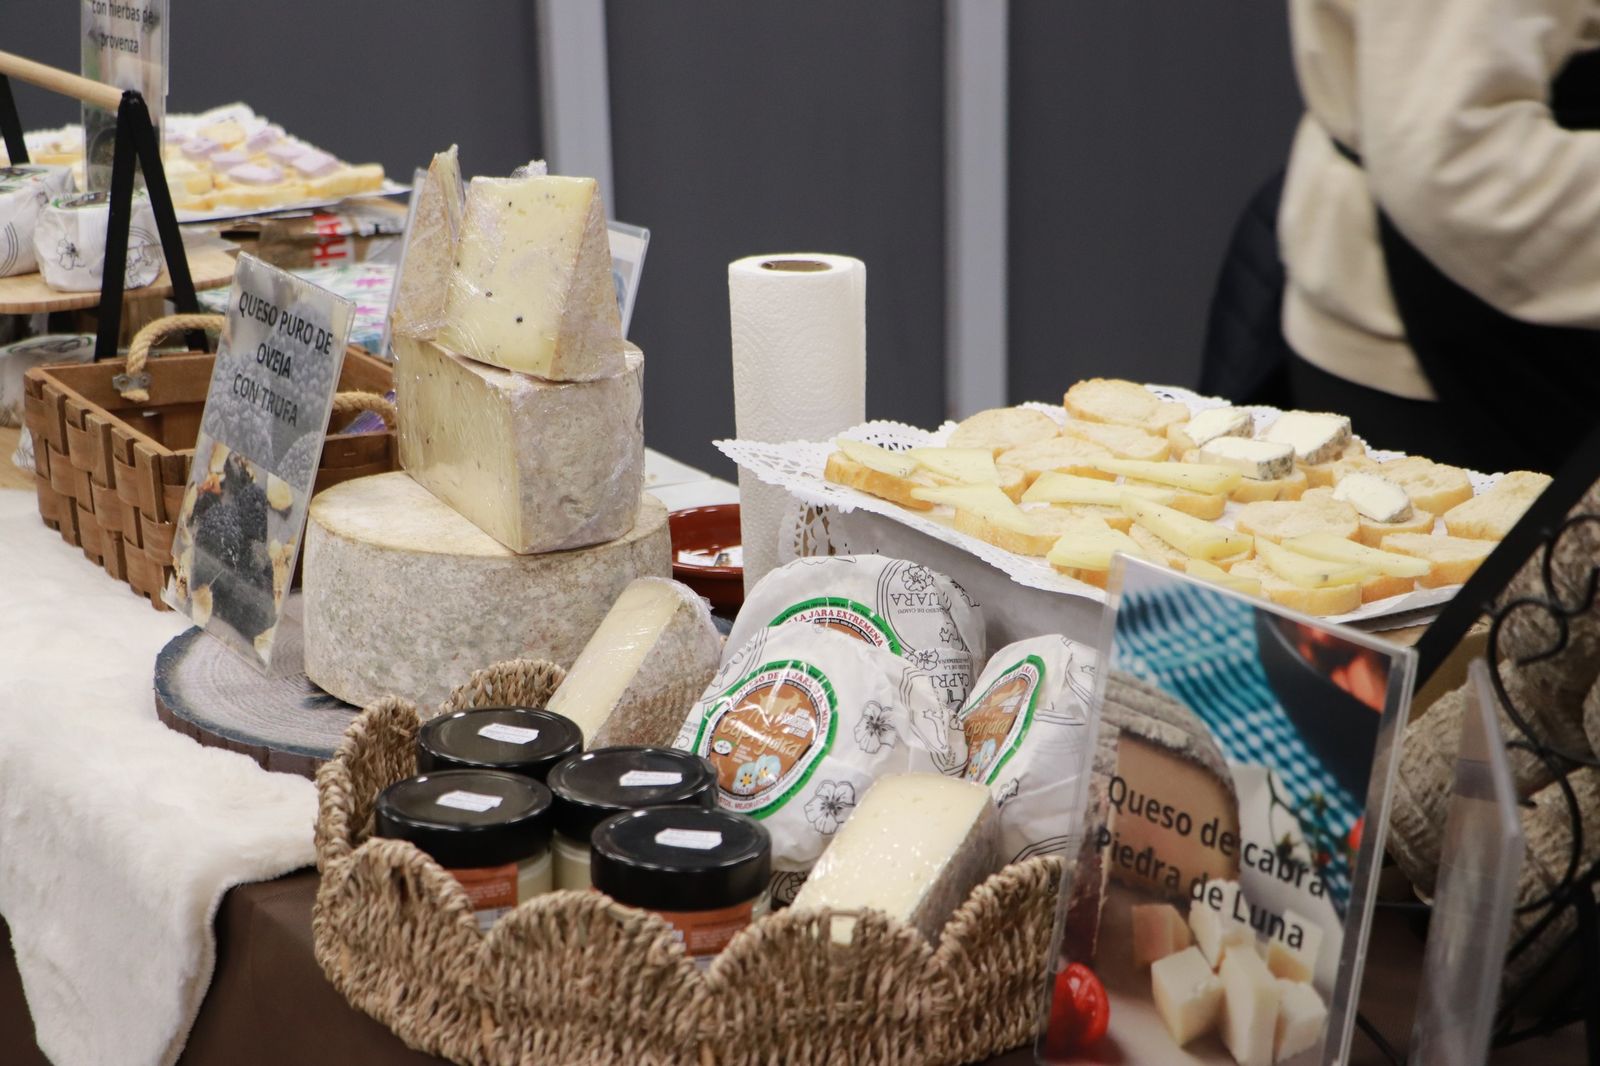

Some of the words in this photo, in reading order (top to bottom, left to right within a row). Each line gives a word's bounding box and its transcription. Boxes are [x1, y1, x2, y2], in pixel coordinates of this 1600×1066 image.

[142, 6, 154, 24] de
[99, 32, 139, 54] provenza
[239, 291, 279, 327] QUESO
[279, 310, 314, 346] PURO
[315, 327, 334, 355] DE
[233, 373, 259, 404] CON
[261, 386, 299, 428] TRUFA
[808, 609, 834, 619] JARA
[1108, 776, 1192, 837] Queso
[1200, 817, 1234, 856] de
[1243, 841, 1325, 898] cabra
[1096, 827, 1181, 895] Piedra
[1190, 872, 1224, 911] de
[1232, 891, 1305, 951] Luna
